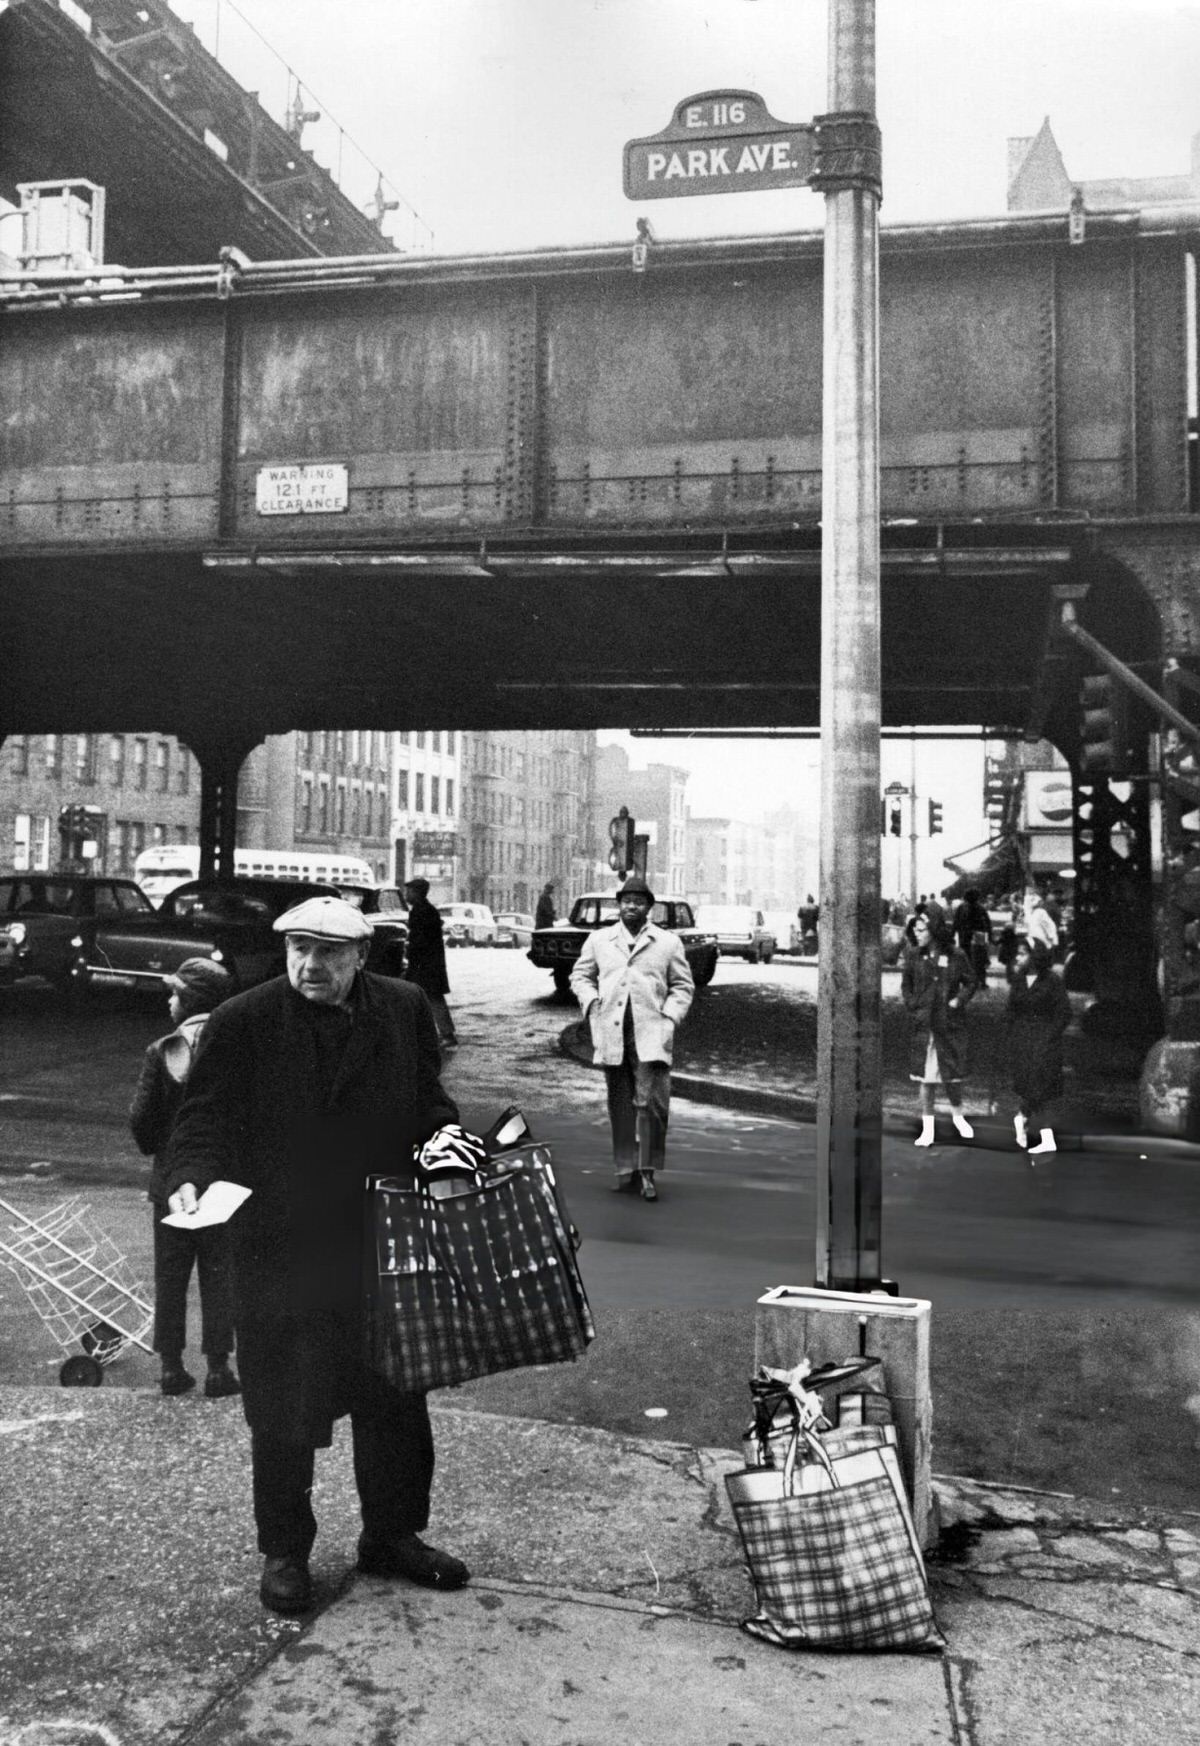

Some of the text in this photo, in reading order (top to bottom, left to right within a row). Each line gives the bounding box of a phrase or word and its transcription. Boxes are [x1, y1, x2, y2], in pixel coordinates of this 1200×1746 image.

[686, 103, 746, 128] E. 116
[647, 142, 798, 180] PARK AVE.
[269, 469, 334, 480] WARNING
[311, 484, 326, 495] FT
[261, 498, 342, 511] CLEARANCE
